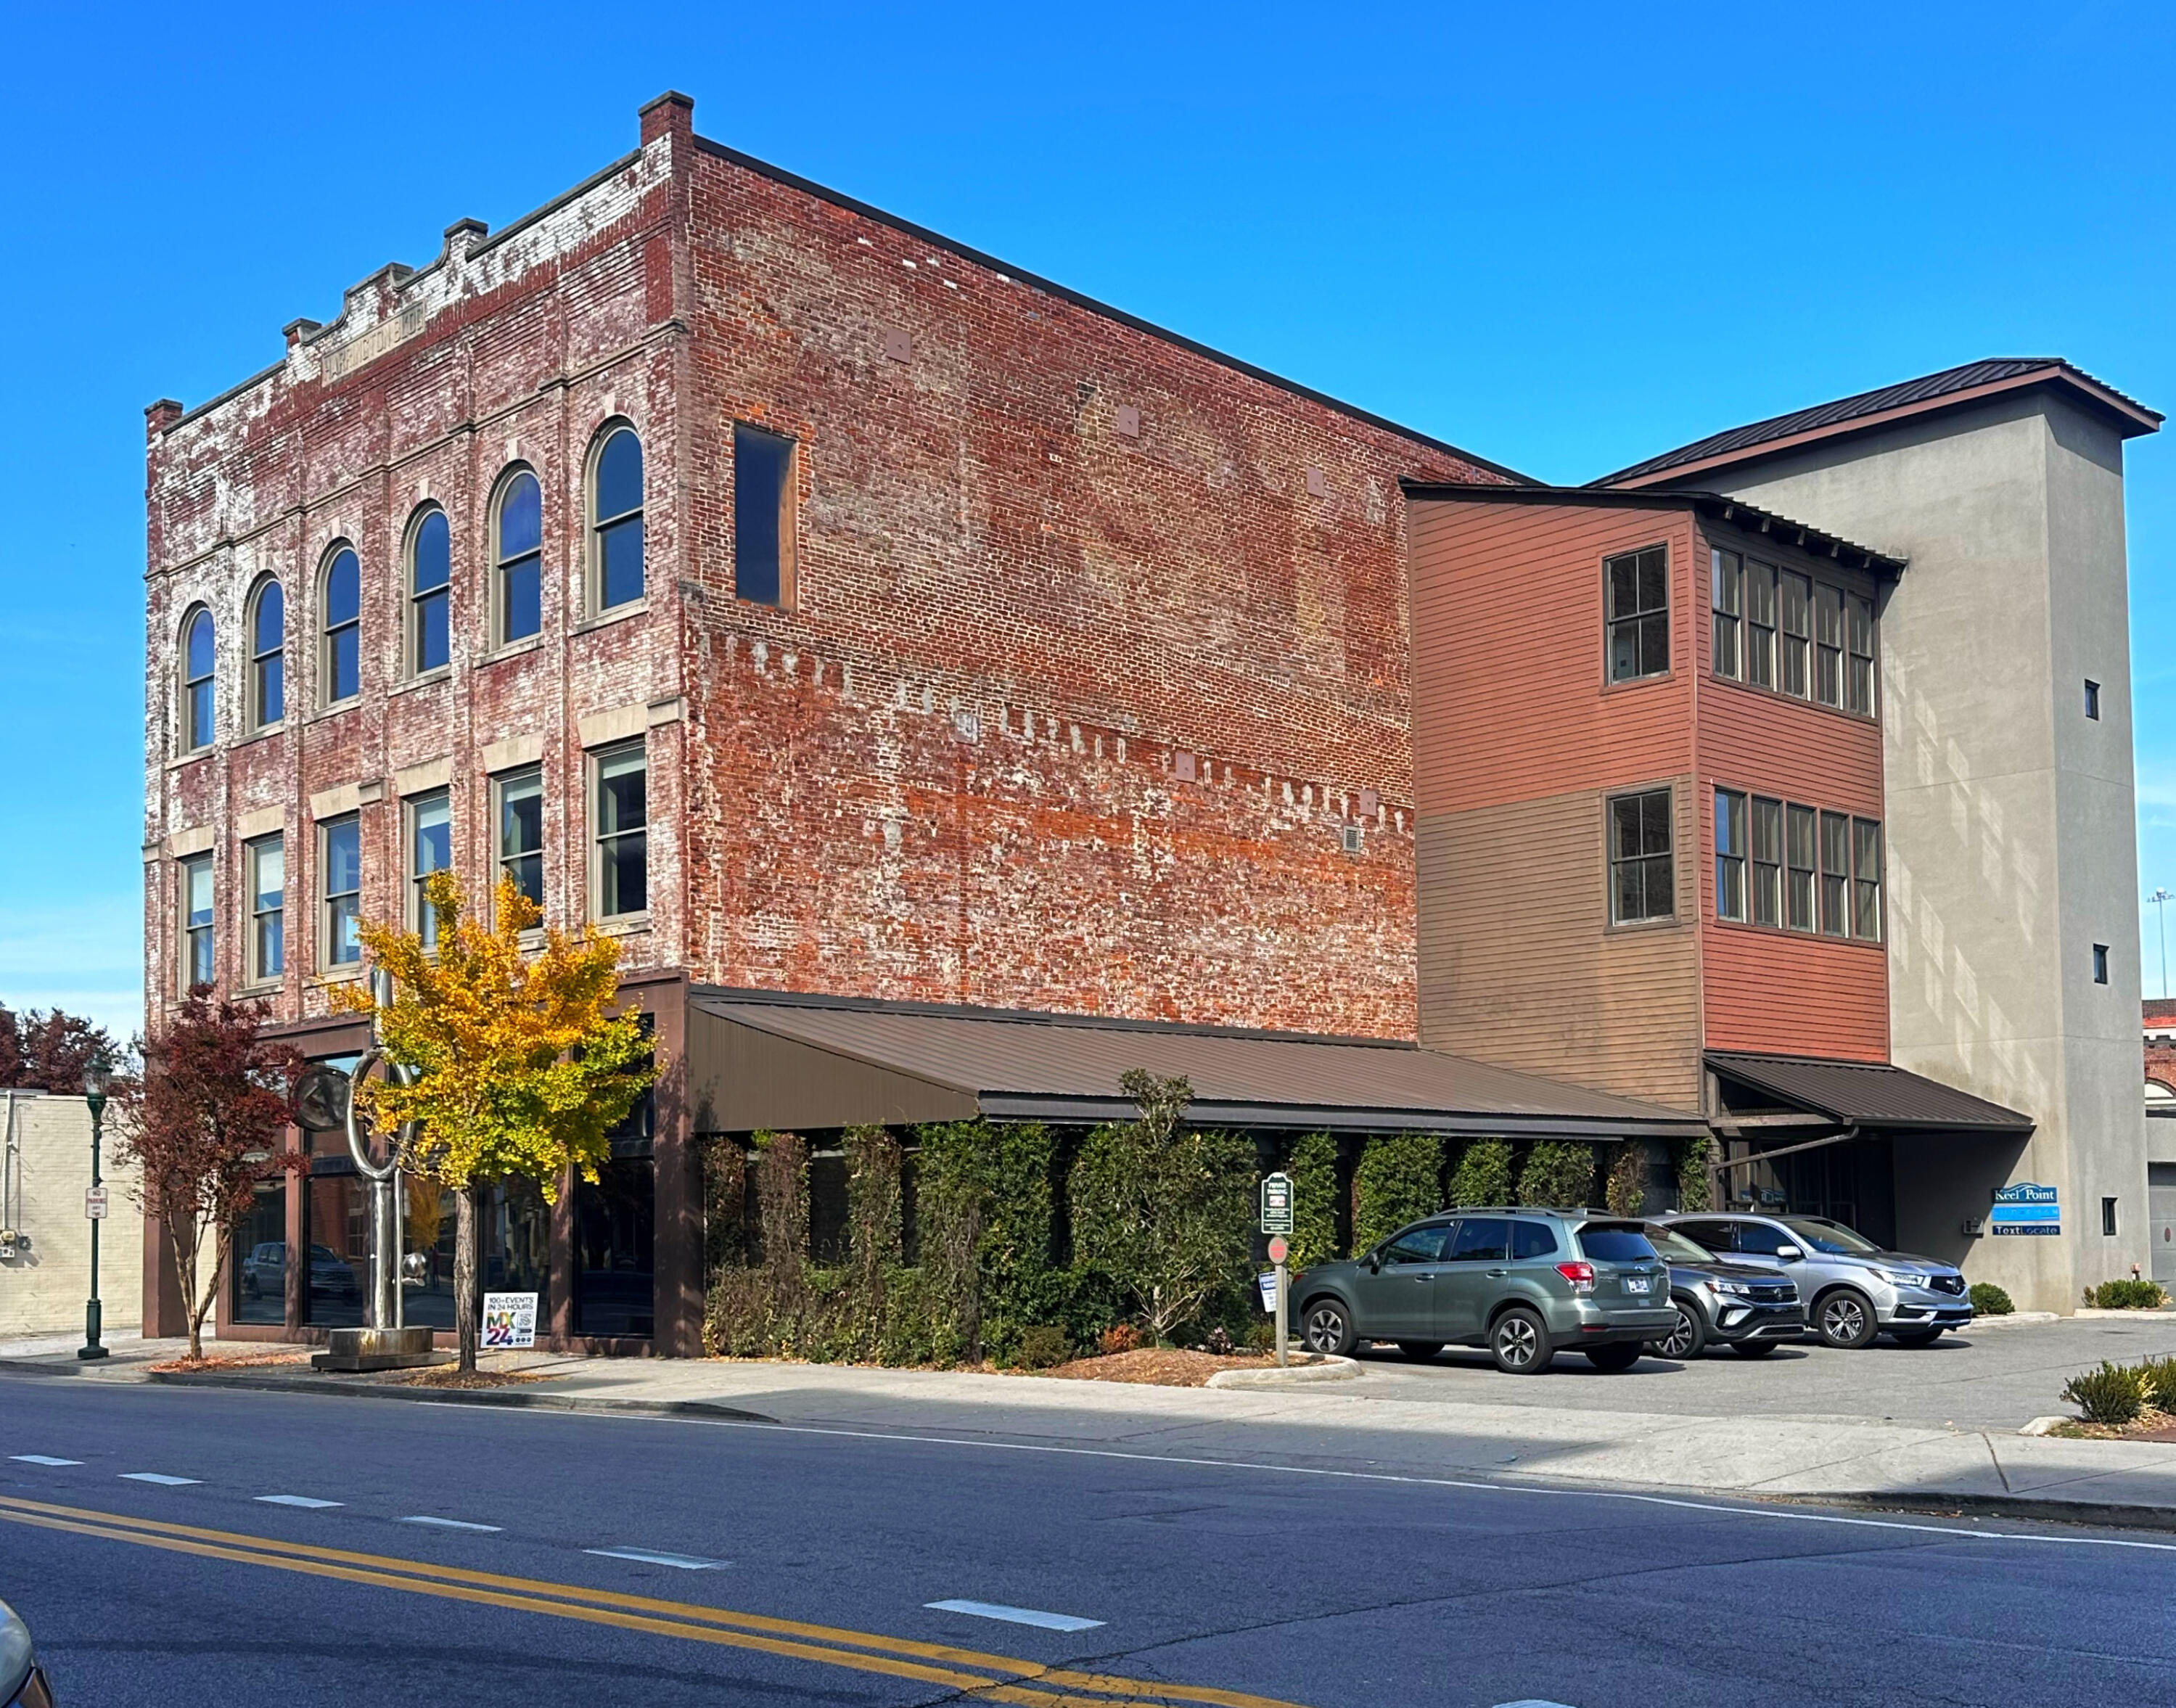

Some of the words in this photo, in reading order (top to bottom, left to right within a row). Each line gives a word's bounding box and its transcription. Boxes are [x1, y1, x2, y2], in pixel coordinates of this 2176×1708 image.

[1995, 1190, 2019, 1200] Keel
[2026, 1189, 2054, 1200] Point
[486, 1328, 514, 1345] 24
